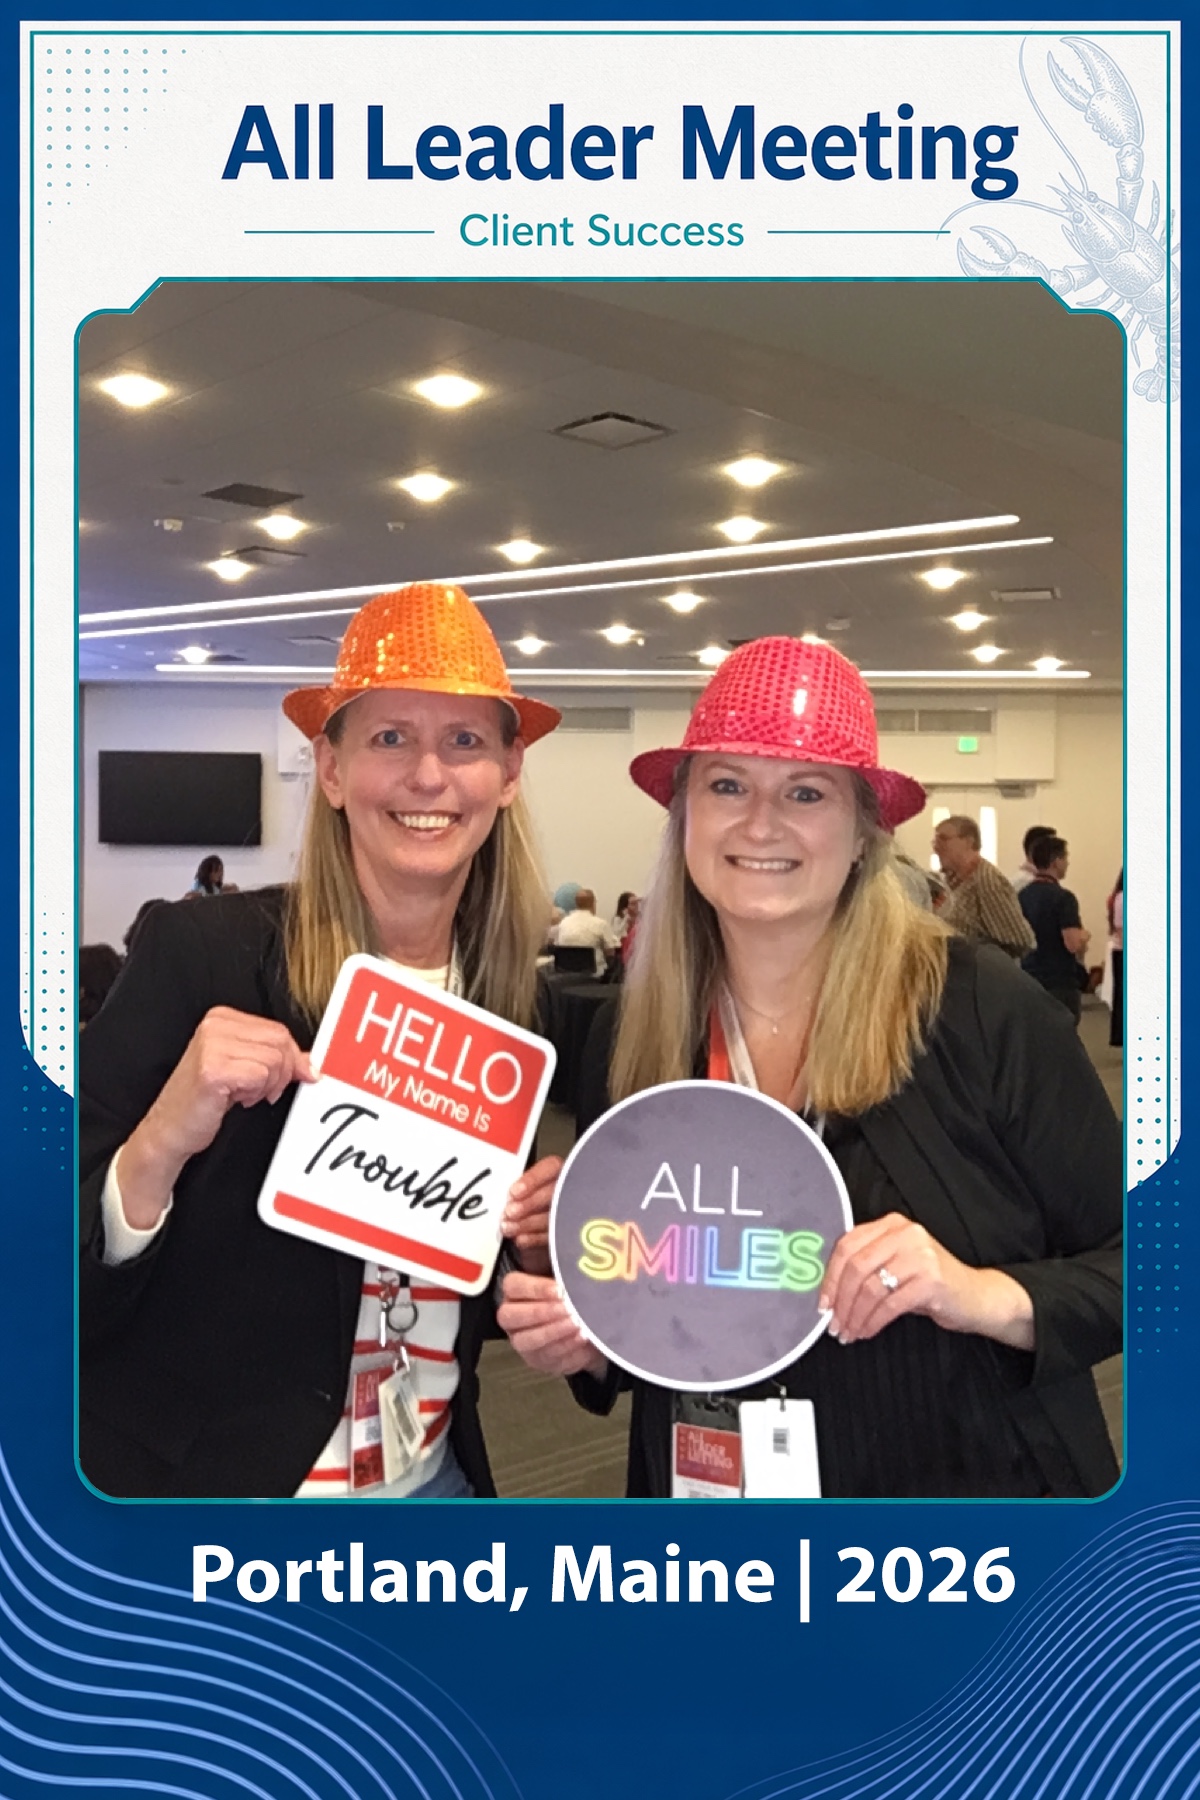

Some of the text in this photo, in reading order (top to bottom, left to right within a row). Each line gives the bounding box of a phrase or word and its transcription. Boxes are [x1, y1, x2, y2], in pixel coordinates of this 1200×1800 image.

[355, 991, 522, 1104] HELLO
[363, 1060, 491, 1133] My Name Is
[304, 1103, 492, 1222] Trouble
[641, 1162, 763, 1216] ALL
[578, 1218, 824, 1292] SMILES
